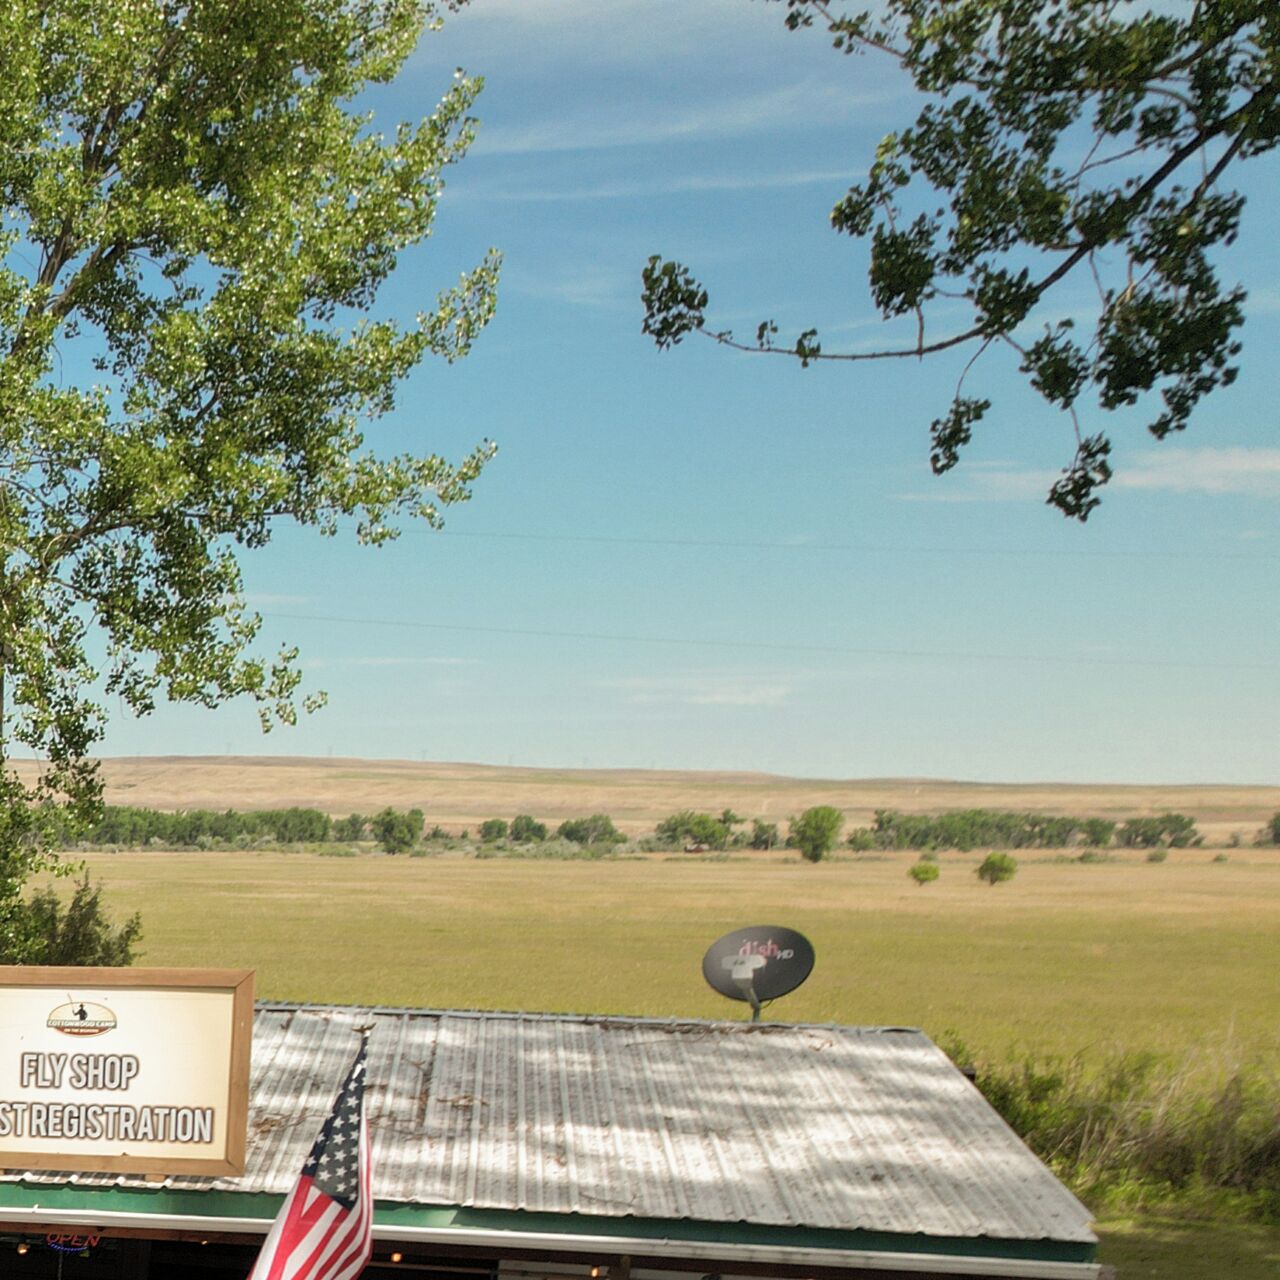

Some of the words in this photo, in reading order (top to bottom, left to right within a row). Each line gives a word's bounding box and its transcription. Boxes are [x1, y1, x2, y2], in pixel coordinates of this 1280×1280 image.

[20, 1051, 68, 1088] FLY
[68, 1053, 139, 1091] SHOP
[29, 1102, 215, 1143] REGISTRATION
[47, 1232, 101, 1247] OPEN
